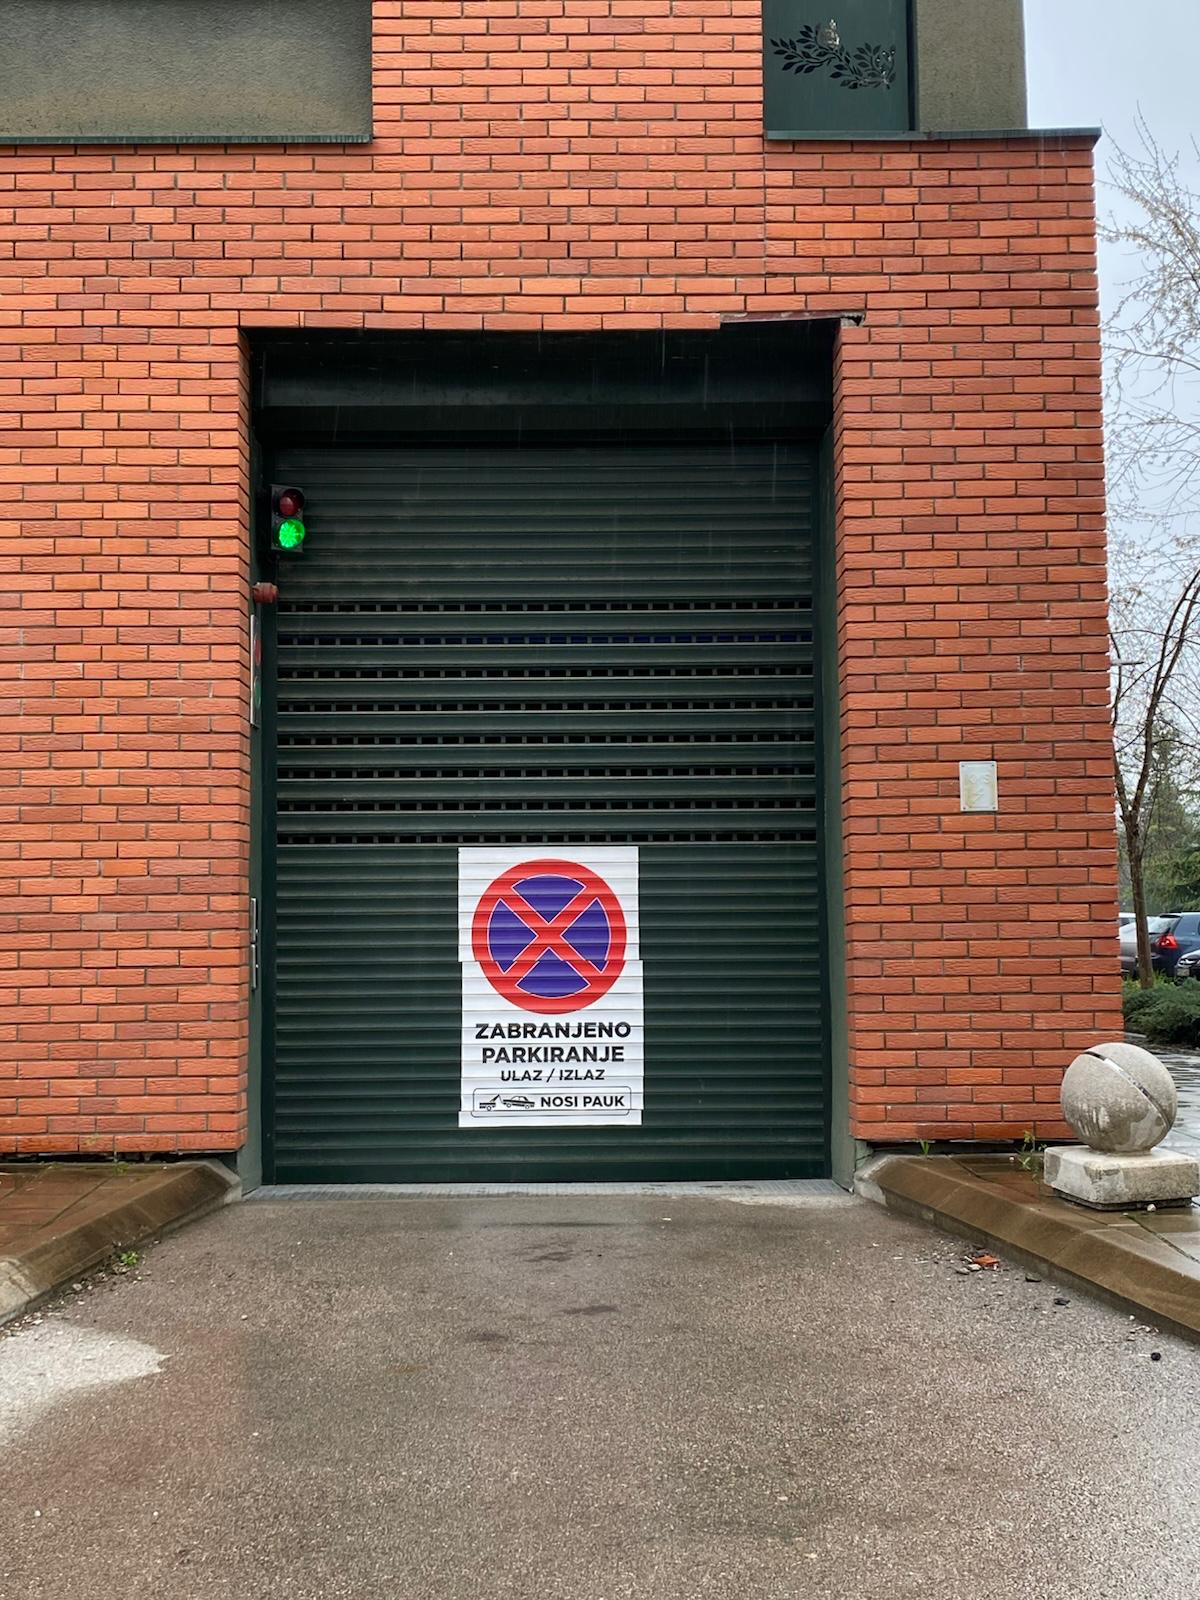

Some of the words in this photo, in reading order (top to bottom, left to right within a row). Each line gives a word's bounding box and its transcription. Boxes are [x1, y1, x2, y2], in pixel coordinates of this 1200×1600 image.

[475, 1022, 631, 1039] ZABRANJENO
[482, 1046, 625, 1063] PARKIRANJE
[501, 1070, 543, 1082] ULAZ
[546, 1068, 555, 1083] /
[559, 1069, 606, 1081] IZLAZ
[540, 1096, 578, 1107] NOSI
[583, 1096, 625, 1107] PAUK
